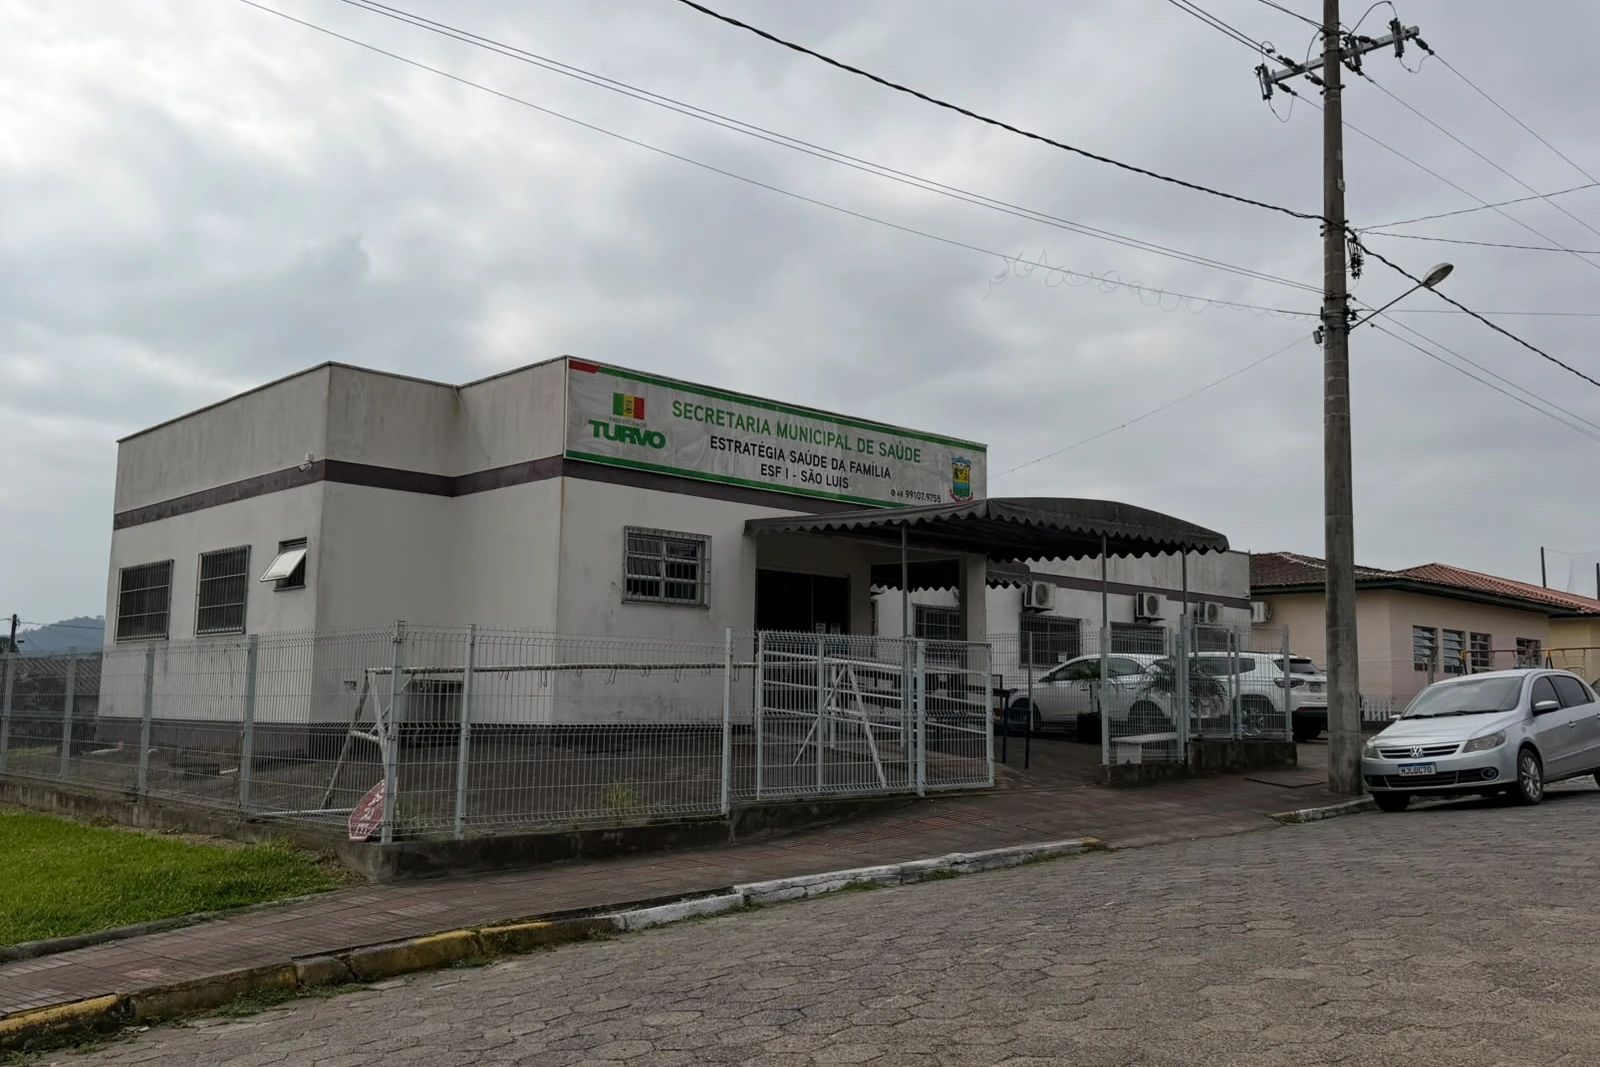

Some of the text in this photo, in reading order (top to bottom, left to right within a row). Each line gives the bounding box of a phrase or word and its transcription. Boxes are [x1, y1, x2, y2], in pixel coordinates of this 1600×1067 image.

[588, 419, 666, 449] TURVO
[672, 400, 921, 463] SECRETARIA MUNICIPAL DE SAÚDE
[710, 435, 892, 480] ESTRATÉGIA SAÚDE DA FAMÍLIA
[760, 463, 782, 478] ESF
[800, 468, 823, 485] SÃO
[826, 477, 849, 489] LUIS
